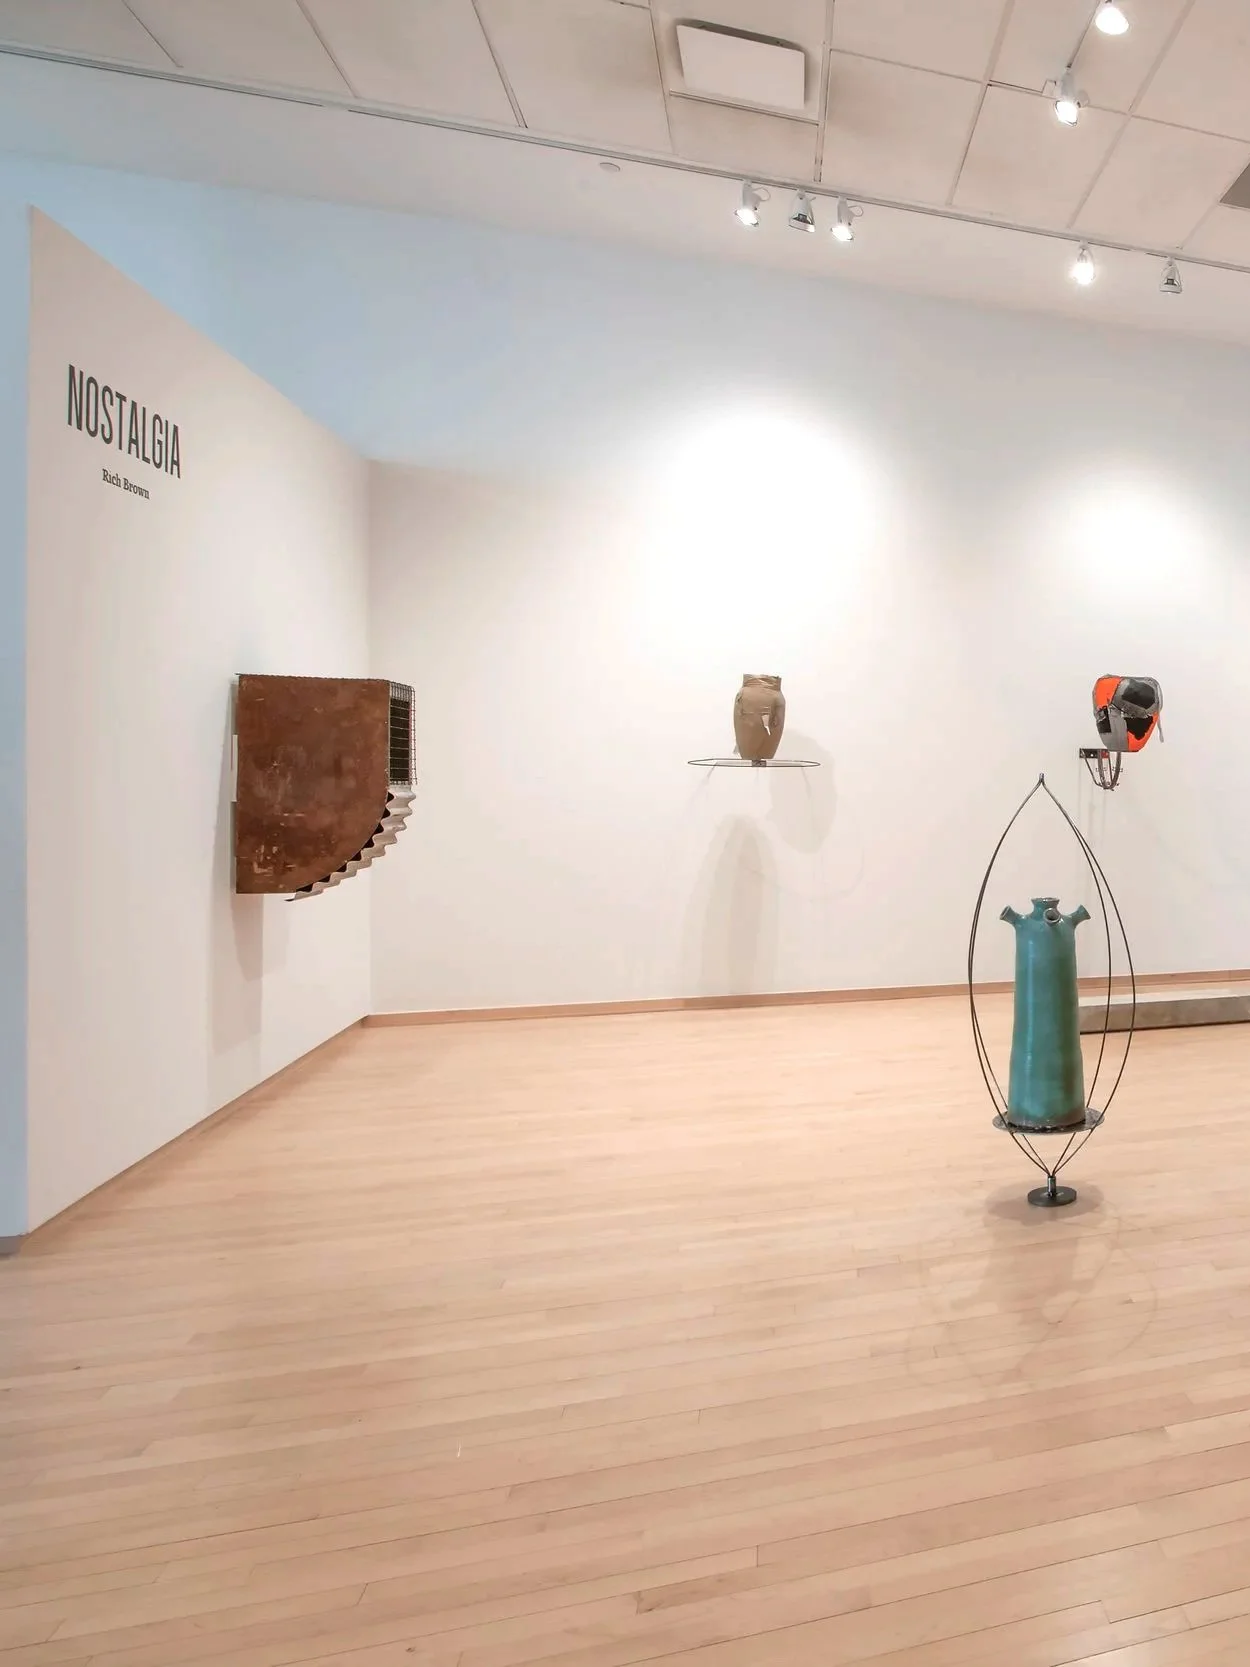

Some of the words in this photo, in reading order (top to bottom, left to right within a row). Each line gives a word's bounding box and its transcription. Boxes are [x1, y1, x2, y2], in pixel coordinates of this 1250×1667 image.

[67, 364, 181, 479] NOSTALGIA
[102, 468, 121, 488] Rich
[123, 478, 150, 499] Brown
